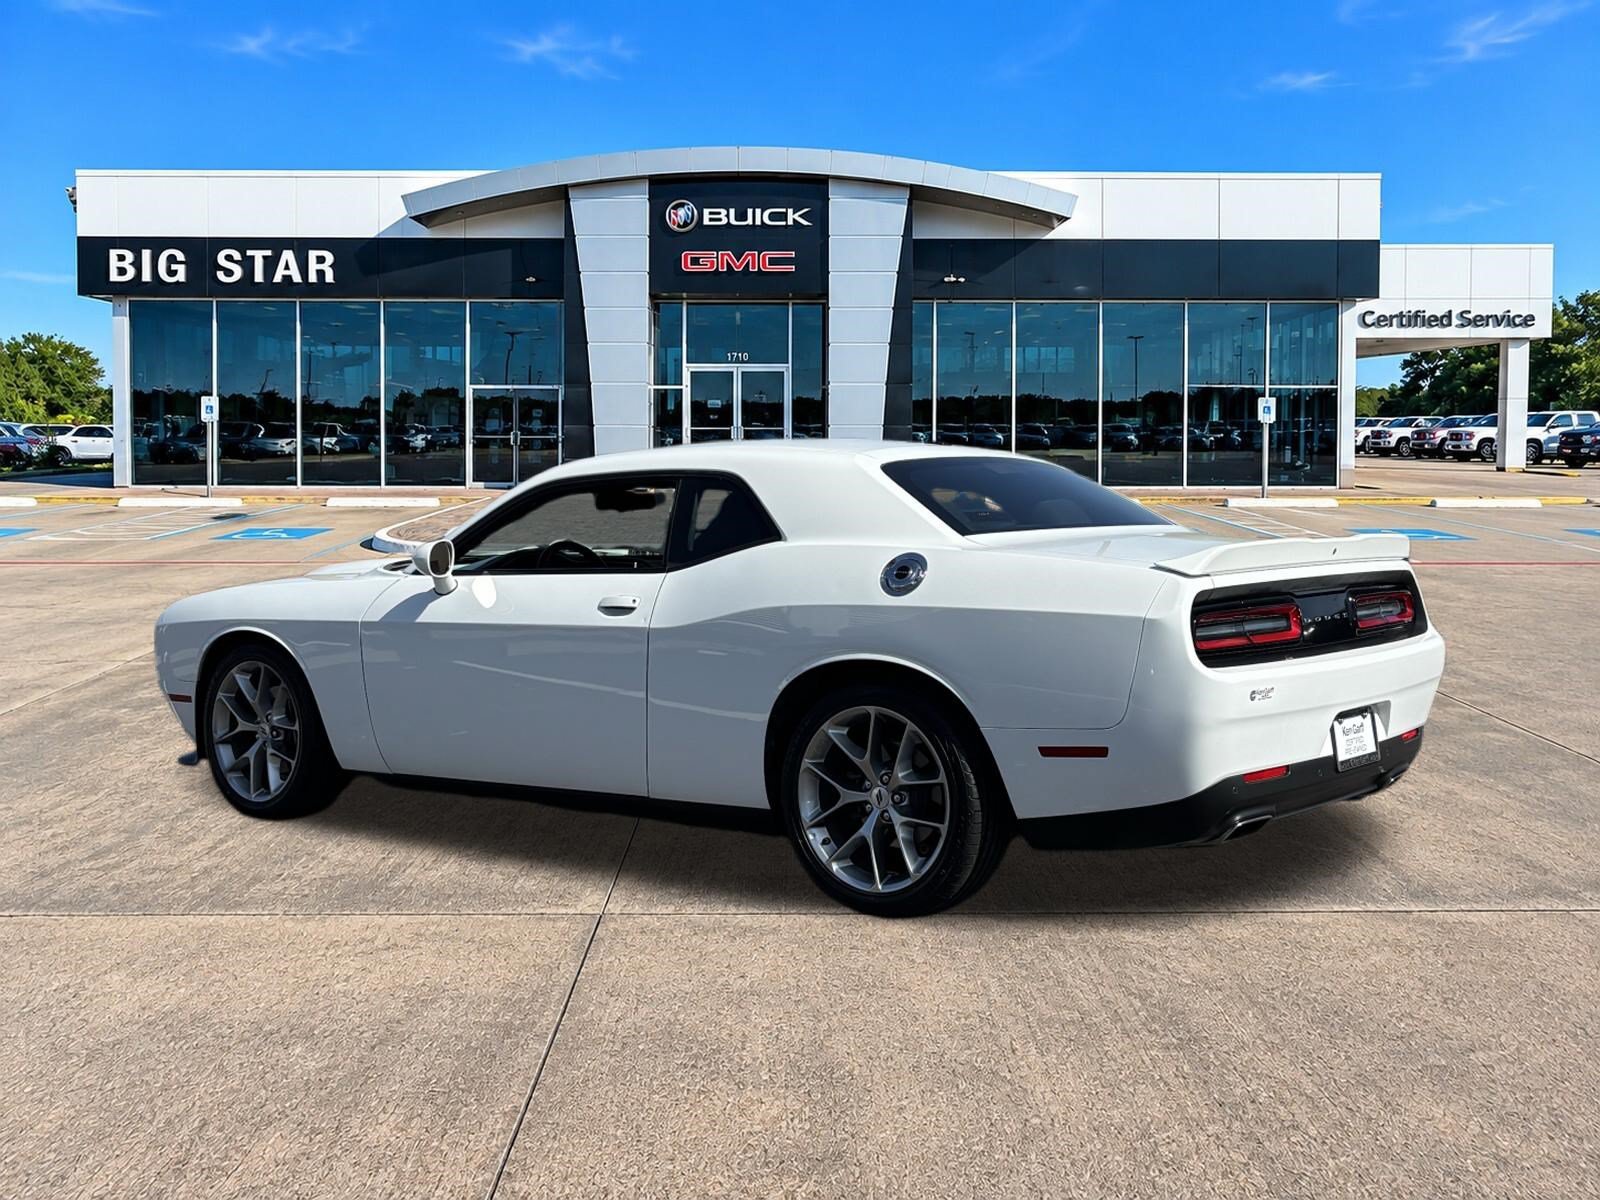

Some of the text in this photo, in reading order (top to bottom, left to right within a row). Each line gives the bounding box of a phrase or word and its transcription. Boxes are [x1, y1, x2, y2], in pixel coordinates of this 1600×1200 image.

[702, 207, 813, 226] BUICK
[108, 248, 336, 284] BIG STAR
[681, 250, 796, 272] GMC
[1359, 309, 1536, 329] Certified Service
[727, 352, 749, 361] 1710
